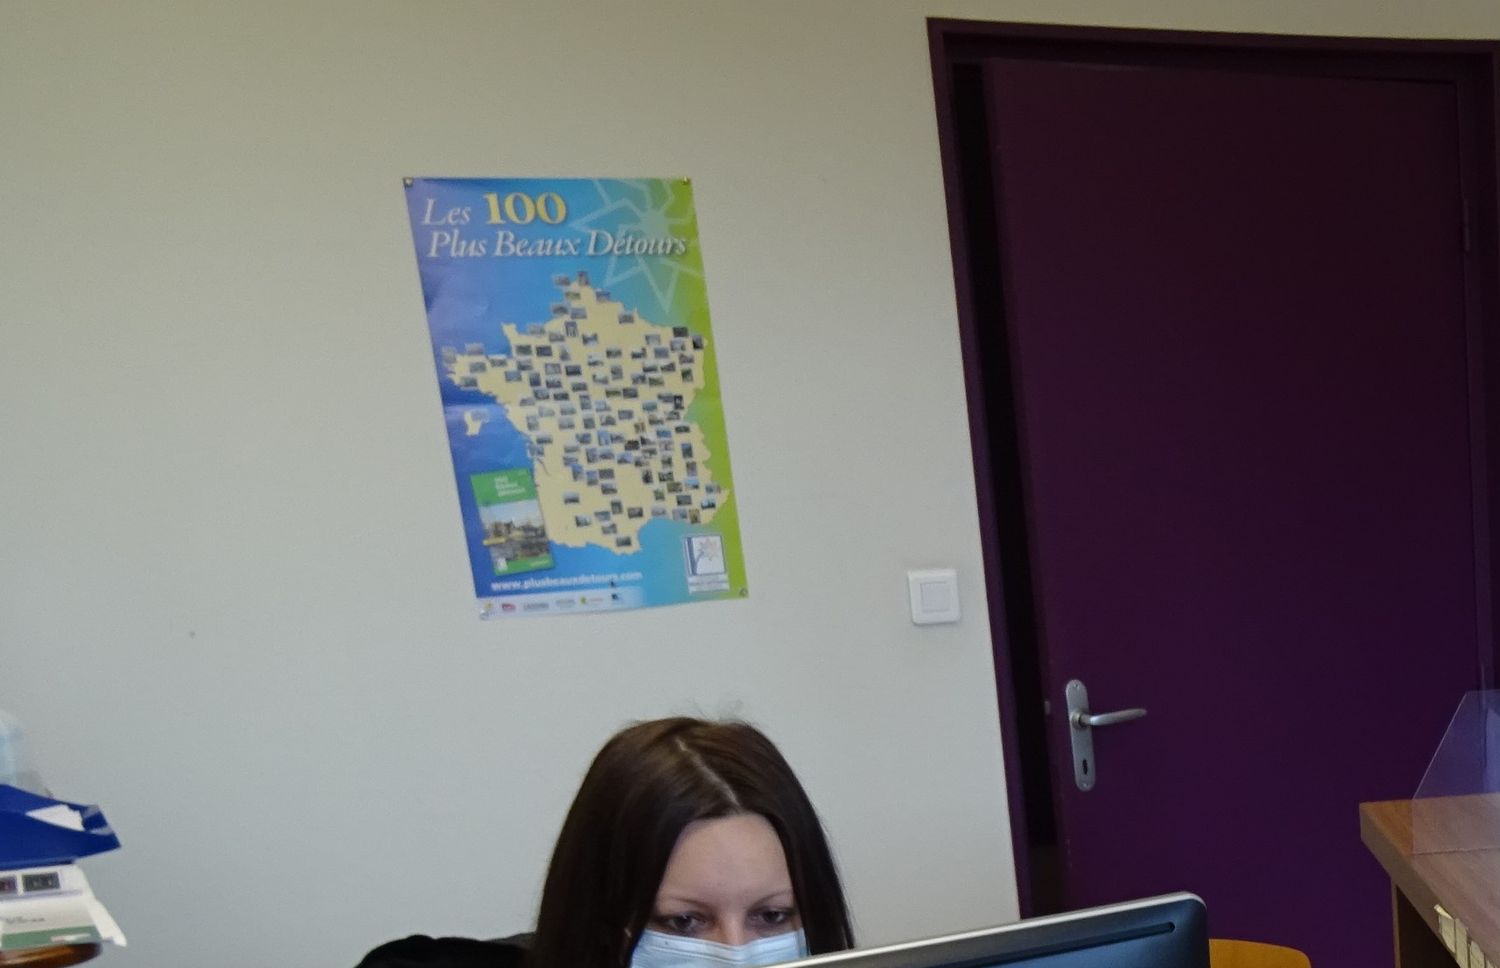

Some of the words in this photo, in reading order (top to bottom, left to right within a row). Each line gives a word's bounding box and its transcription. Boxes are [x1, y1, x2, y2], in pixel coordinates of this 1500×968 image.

[421, 198, 471, 226] Les
[482, 191, 568, 225] 100
[427, 229, 488, 259] Plus
[494, 229, 582, 258] Beaux
[586, 228, 688, 257] Détours
